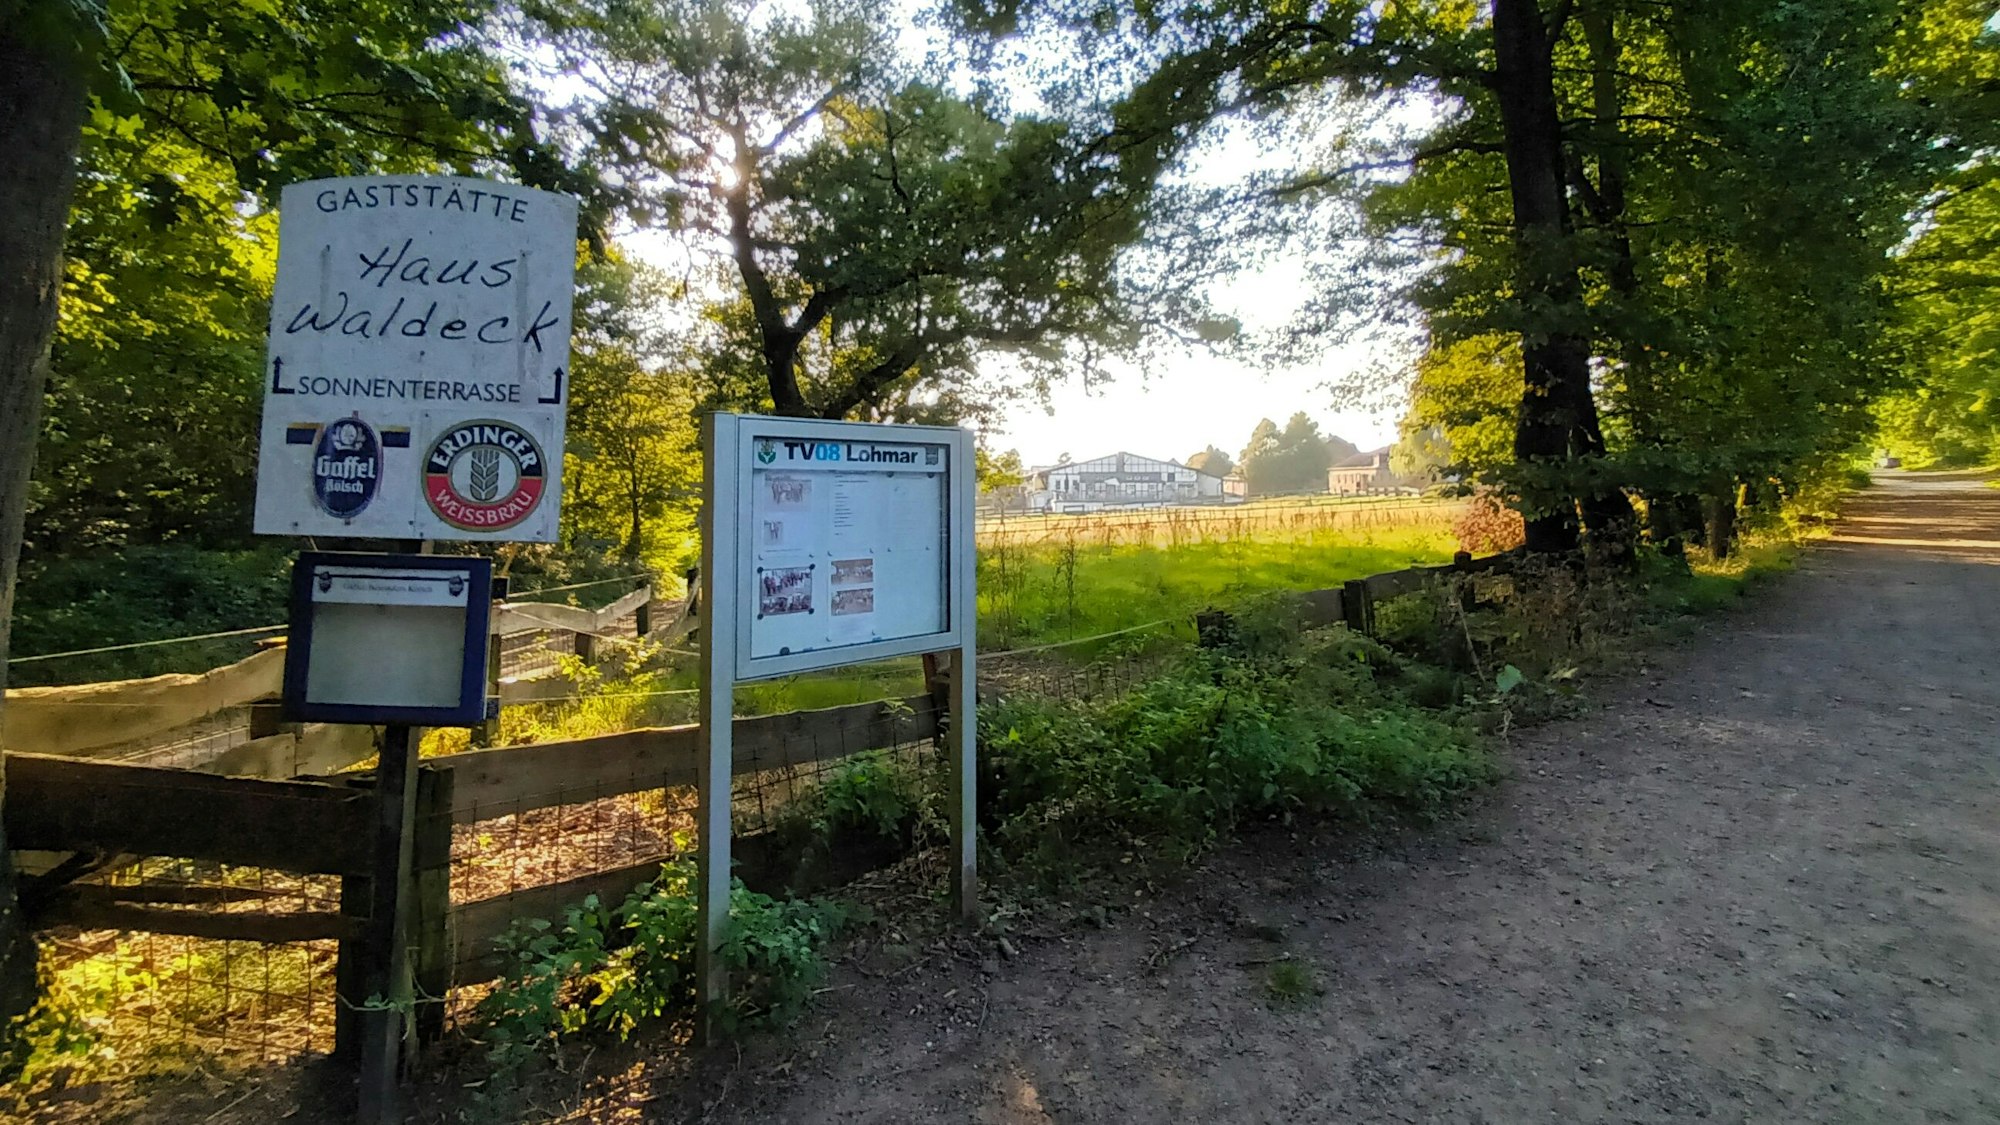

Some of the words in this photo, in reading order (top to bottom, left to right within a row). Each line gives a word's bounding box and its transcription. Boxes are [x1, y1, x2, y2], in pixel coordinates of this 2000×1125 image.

[317, 183, 528, 222] GASTSTÄTTE
[359, 238, 518, 287] Haus
[285, 291, 559, 352] Waldeck
[298, 376, 521, 402] SONNENTERRASSE
[316, 455, 376, 479] Gaffel
[431, 426, 538, 470] ERDINGER
[784, 442, 840, 461] TV08
[846, 444, 919, 464] Lohmar
